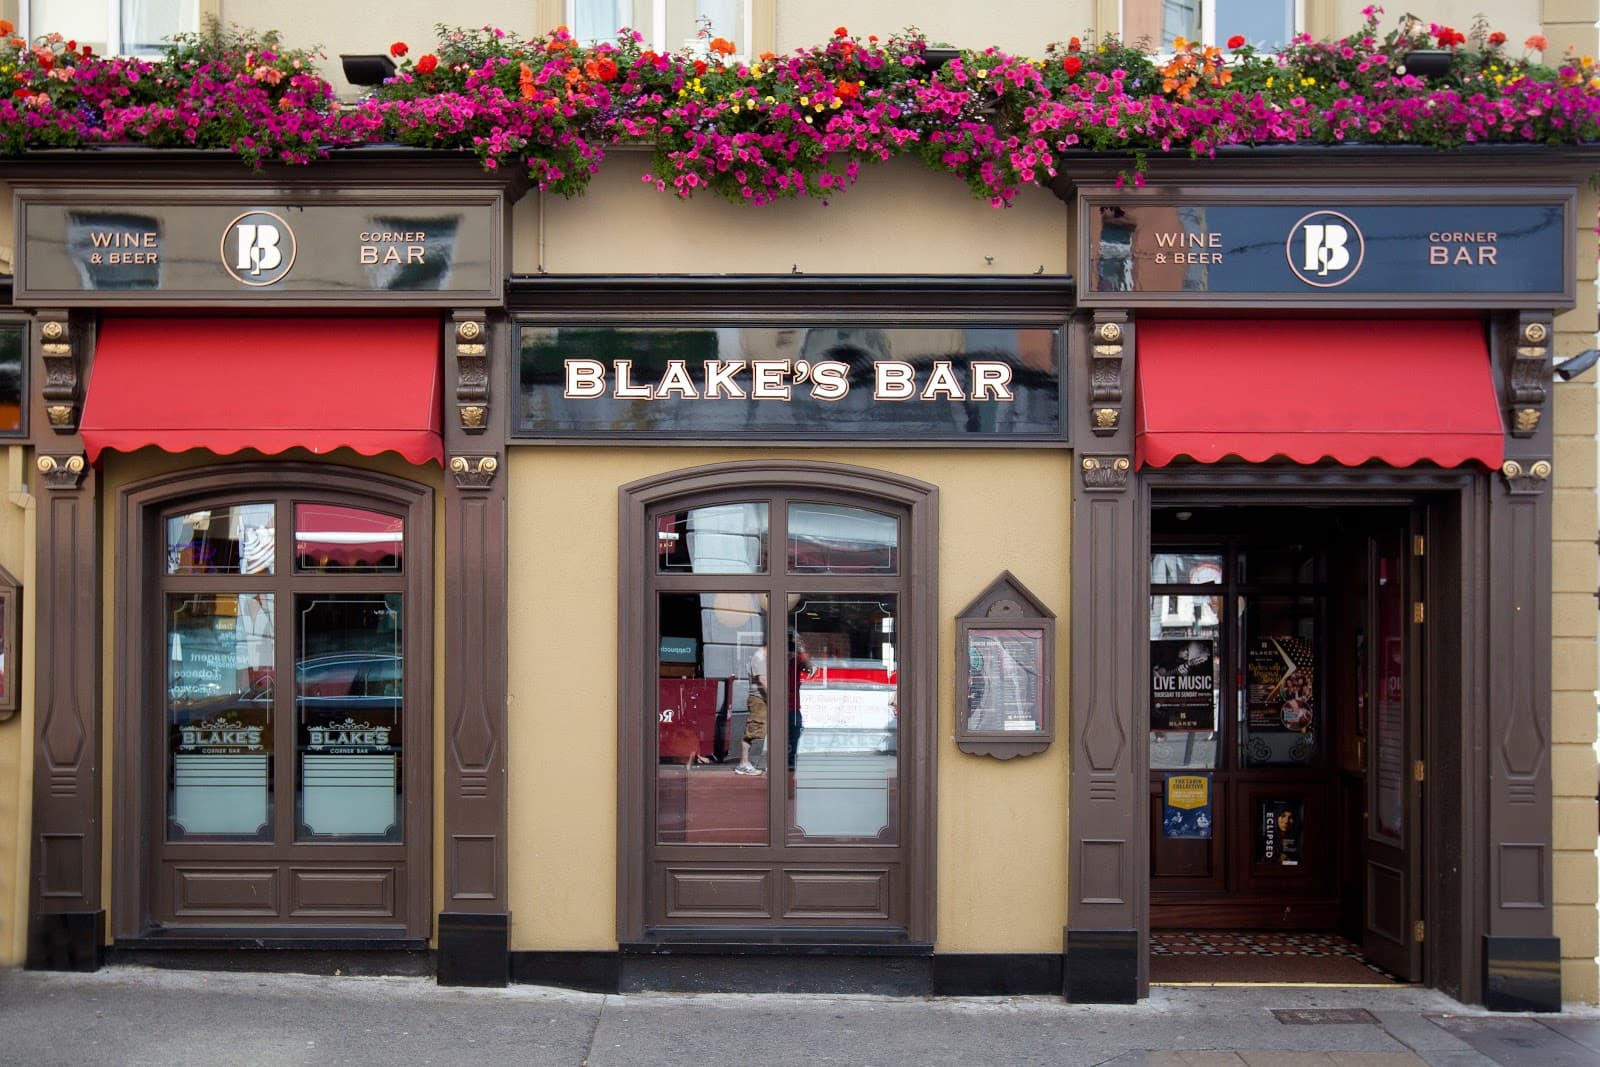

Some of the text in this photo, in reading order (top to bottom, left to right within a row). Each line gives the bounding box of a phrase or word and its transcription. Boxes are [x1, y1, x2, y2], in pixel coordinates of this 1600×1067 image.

[90, 232, 158, 248] WINE
[359, 232, 425, 242] CORNER
[1154, 232, 1223, 248] WINE
[1429, 232, 1498, 242] CORNER
[90, 252, 158, 264] & BEER
[359, 246, 426, 265] BAR
[1154, 252, 1223, 264] & BEER
[1430, 246, 1498, 265] BAR
[563, 358, 1014, 402] BLAKE'S BAR
[1153, 675, 1212, 690] LIVE MUSIC
[1265, 812, 1274, 858] ECLIPSED
